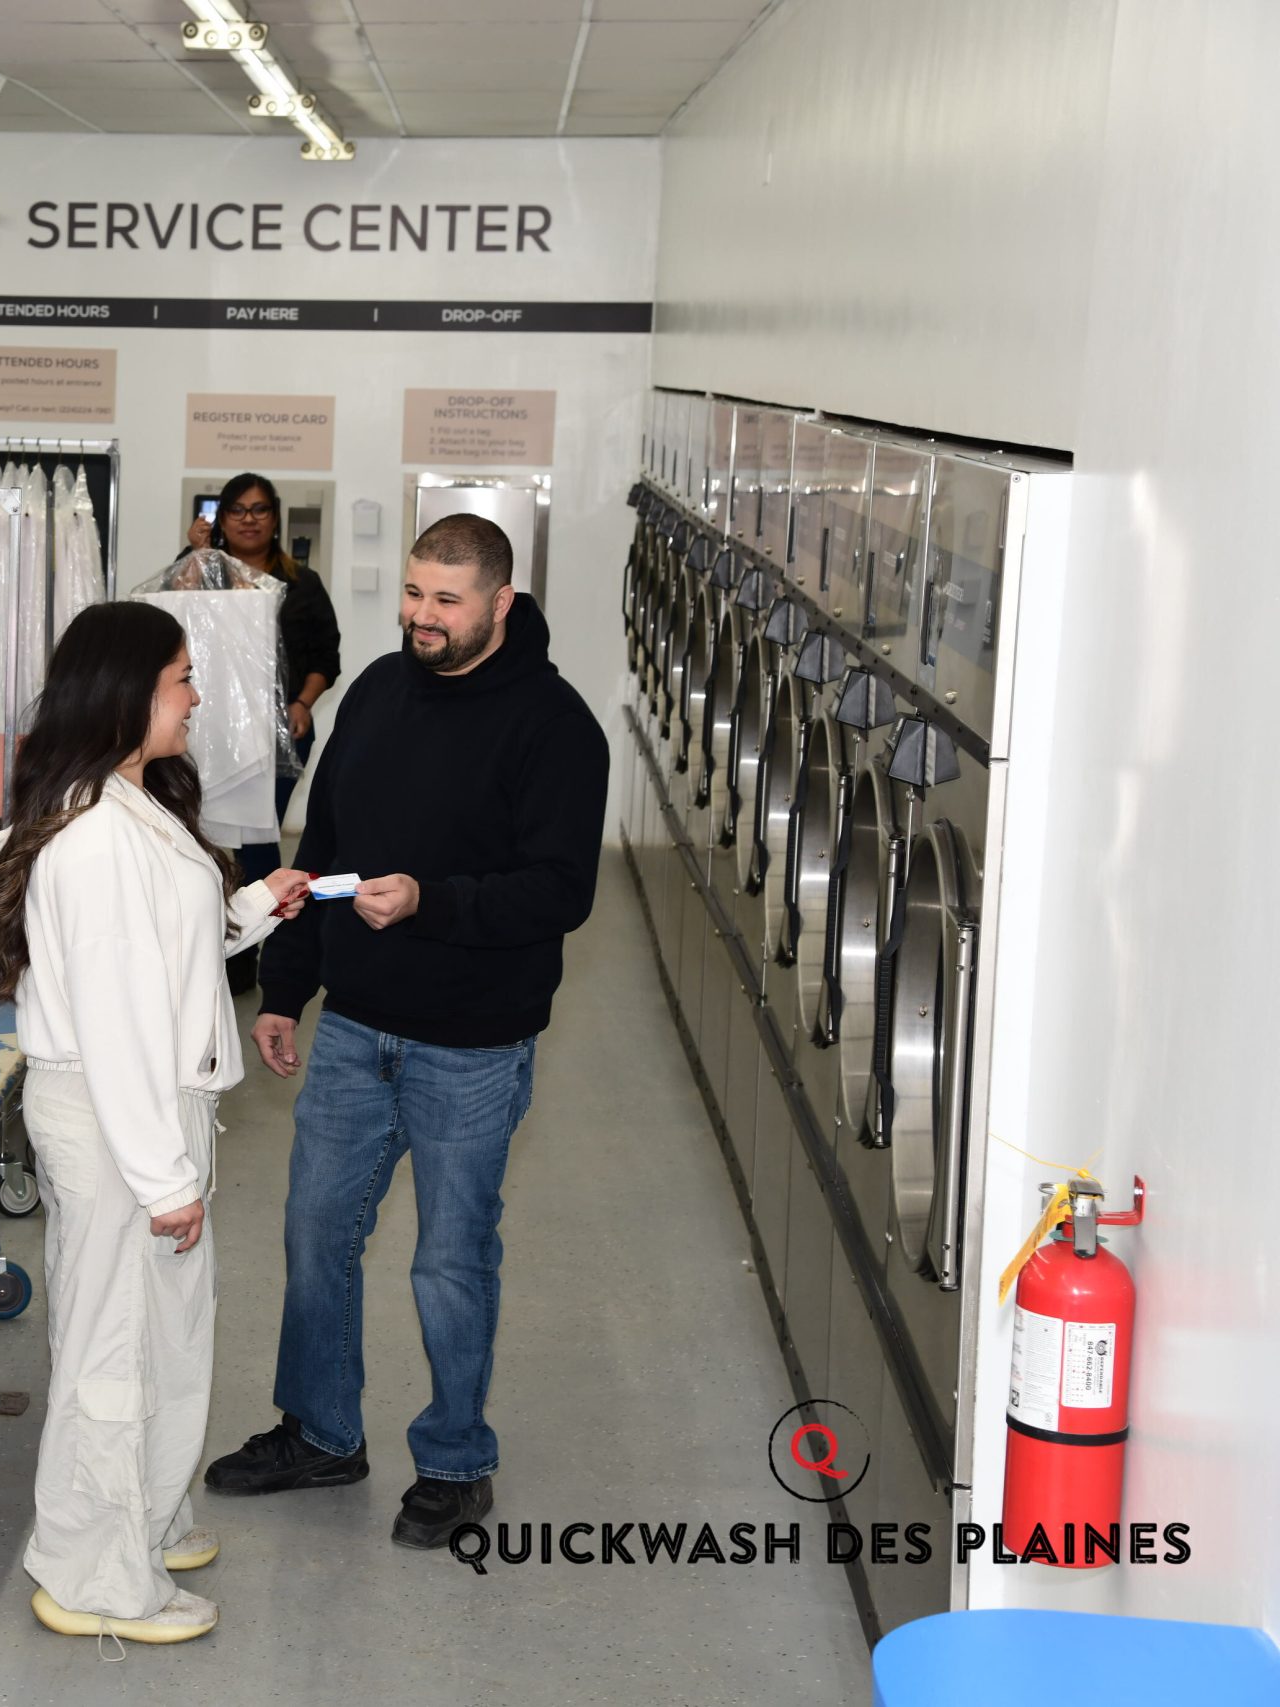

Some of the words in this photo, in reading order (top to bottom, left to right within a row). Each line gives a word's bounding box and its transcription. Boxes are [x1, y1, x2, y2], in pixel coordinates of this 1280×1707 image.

[27, 200, 284, 251] SERVICE
[303, 203, 553, 252] CENTER
[57, 304, 110, 318] HOURS
[226, 306, 257, 320] PAY
[258, 307, 299, 321] HERE
[441, 308, 522, 323] DROP-OFF
[55, 357, 100, 370] HOURS
[0, 377, 29, 387] posted
[30, 377, 54, 387] hours
[66, 379, 102, 388] entrance
[448, 396, 515, 407] DROP-OFF
[193, 411, 252, 423] REGISTER
[255, 413, 289, 424] YOUR
[292, 414, 328, 425] CARD
[433, 408, 528, 420] INSTRUCTIONS
[217, 431, 248, 441] Protect
[249, 434, 267, 443] your
